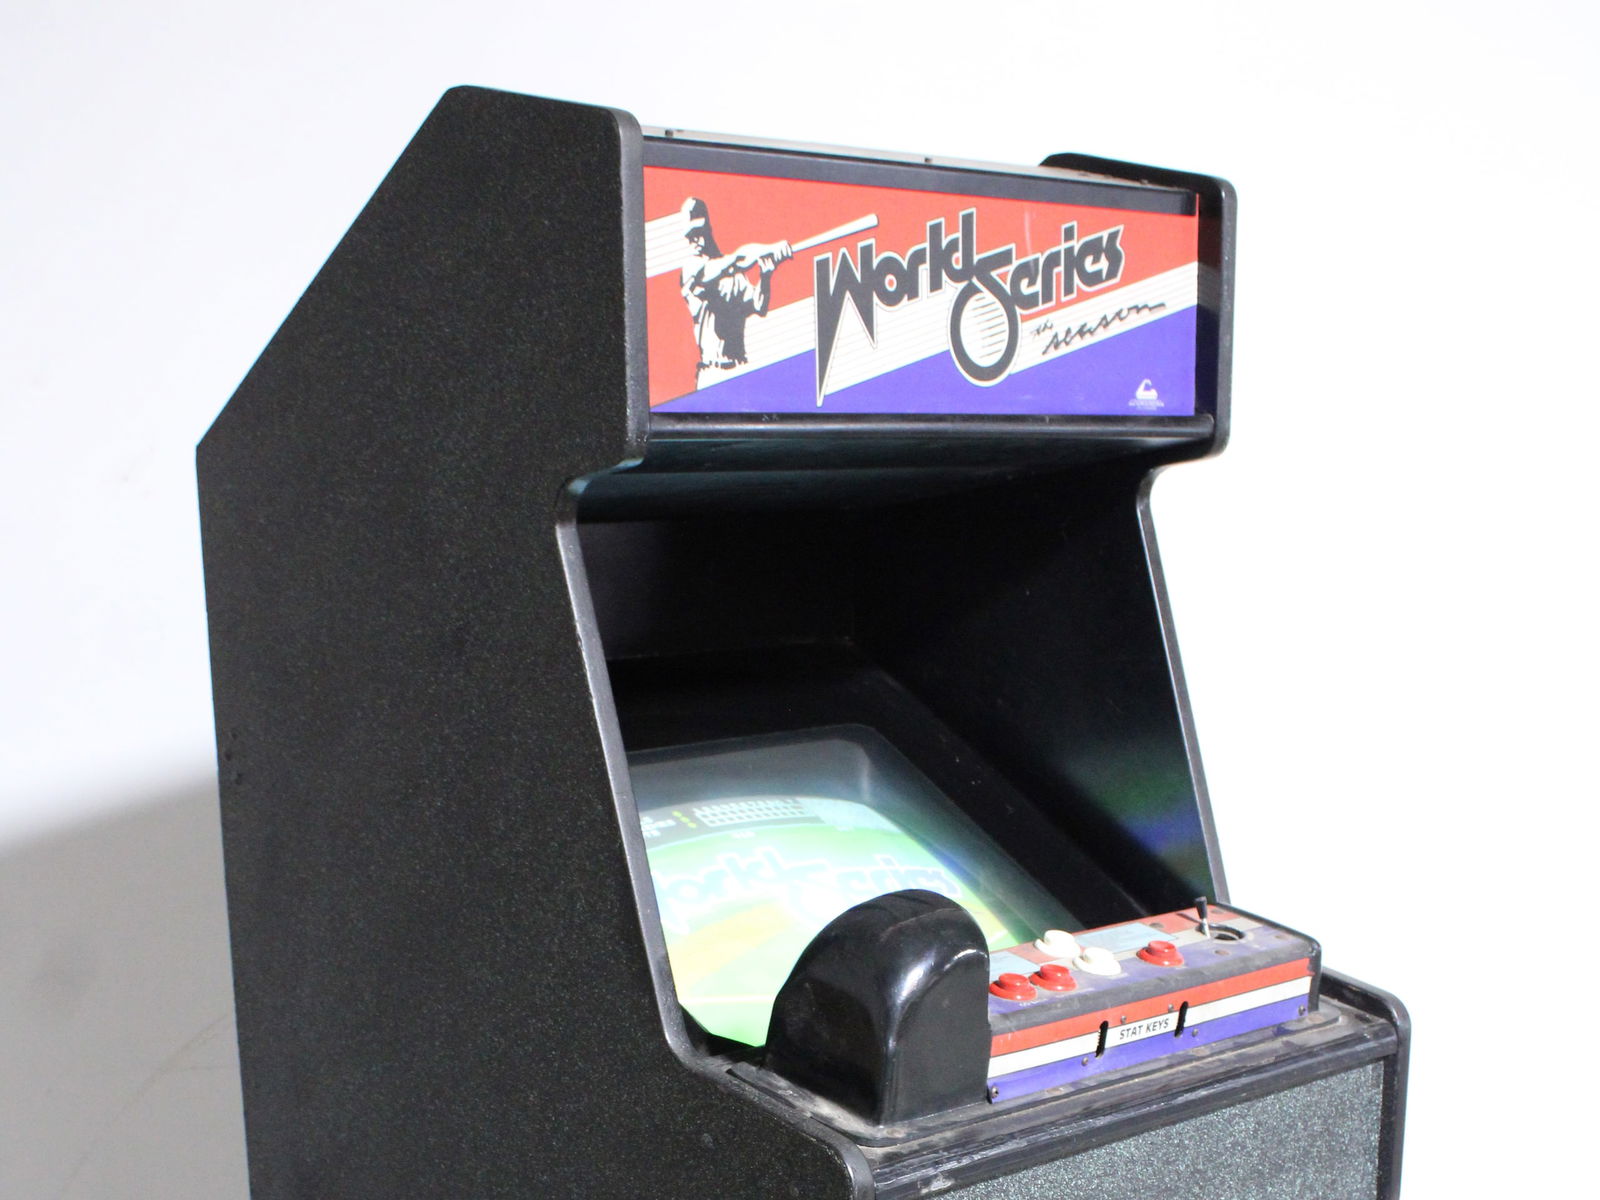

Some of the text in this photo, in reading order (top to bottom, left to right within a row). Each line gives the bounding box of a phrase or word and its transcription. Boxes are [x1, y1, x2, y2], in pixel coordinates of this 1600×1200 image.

[814, 208, 1124, 406] World Series
[1042, 302, 1166, 355] season
[1119, 1018, 1169, 1040] STAT KEYS
